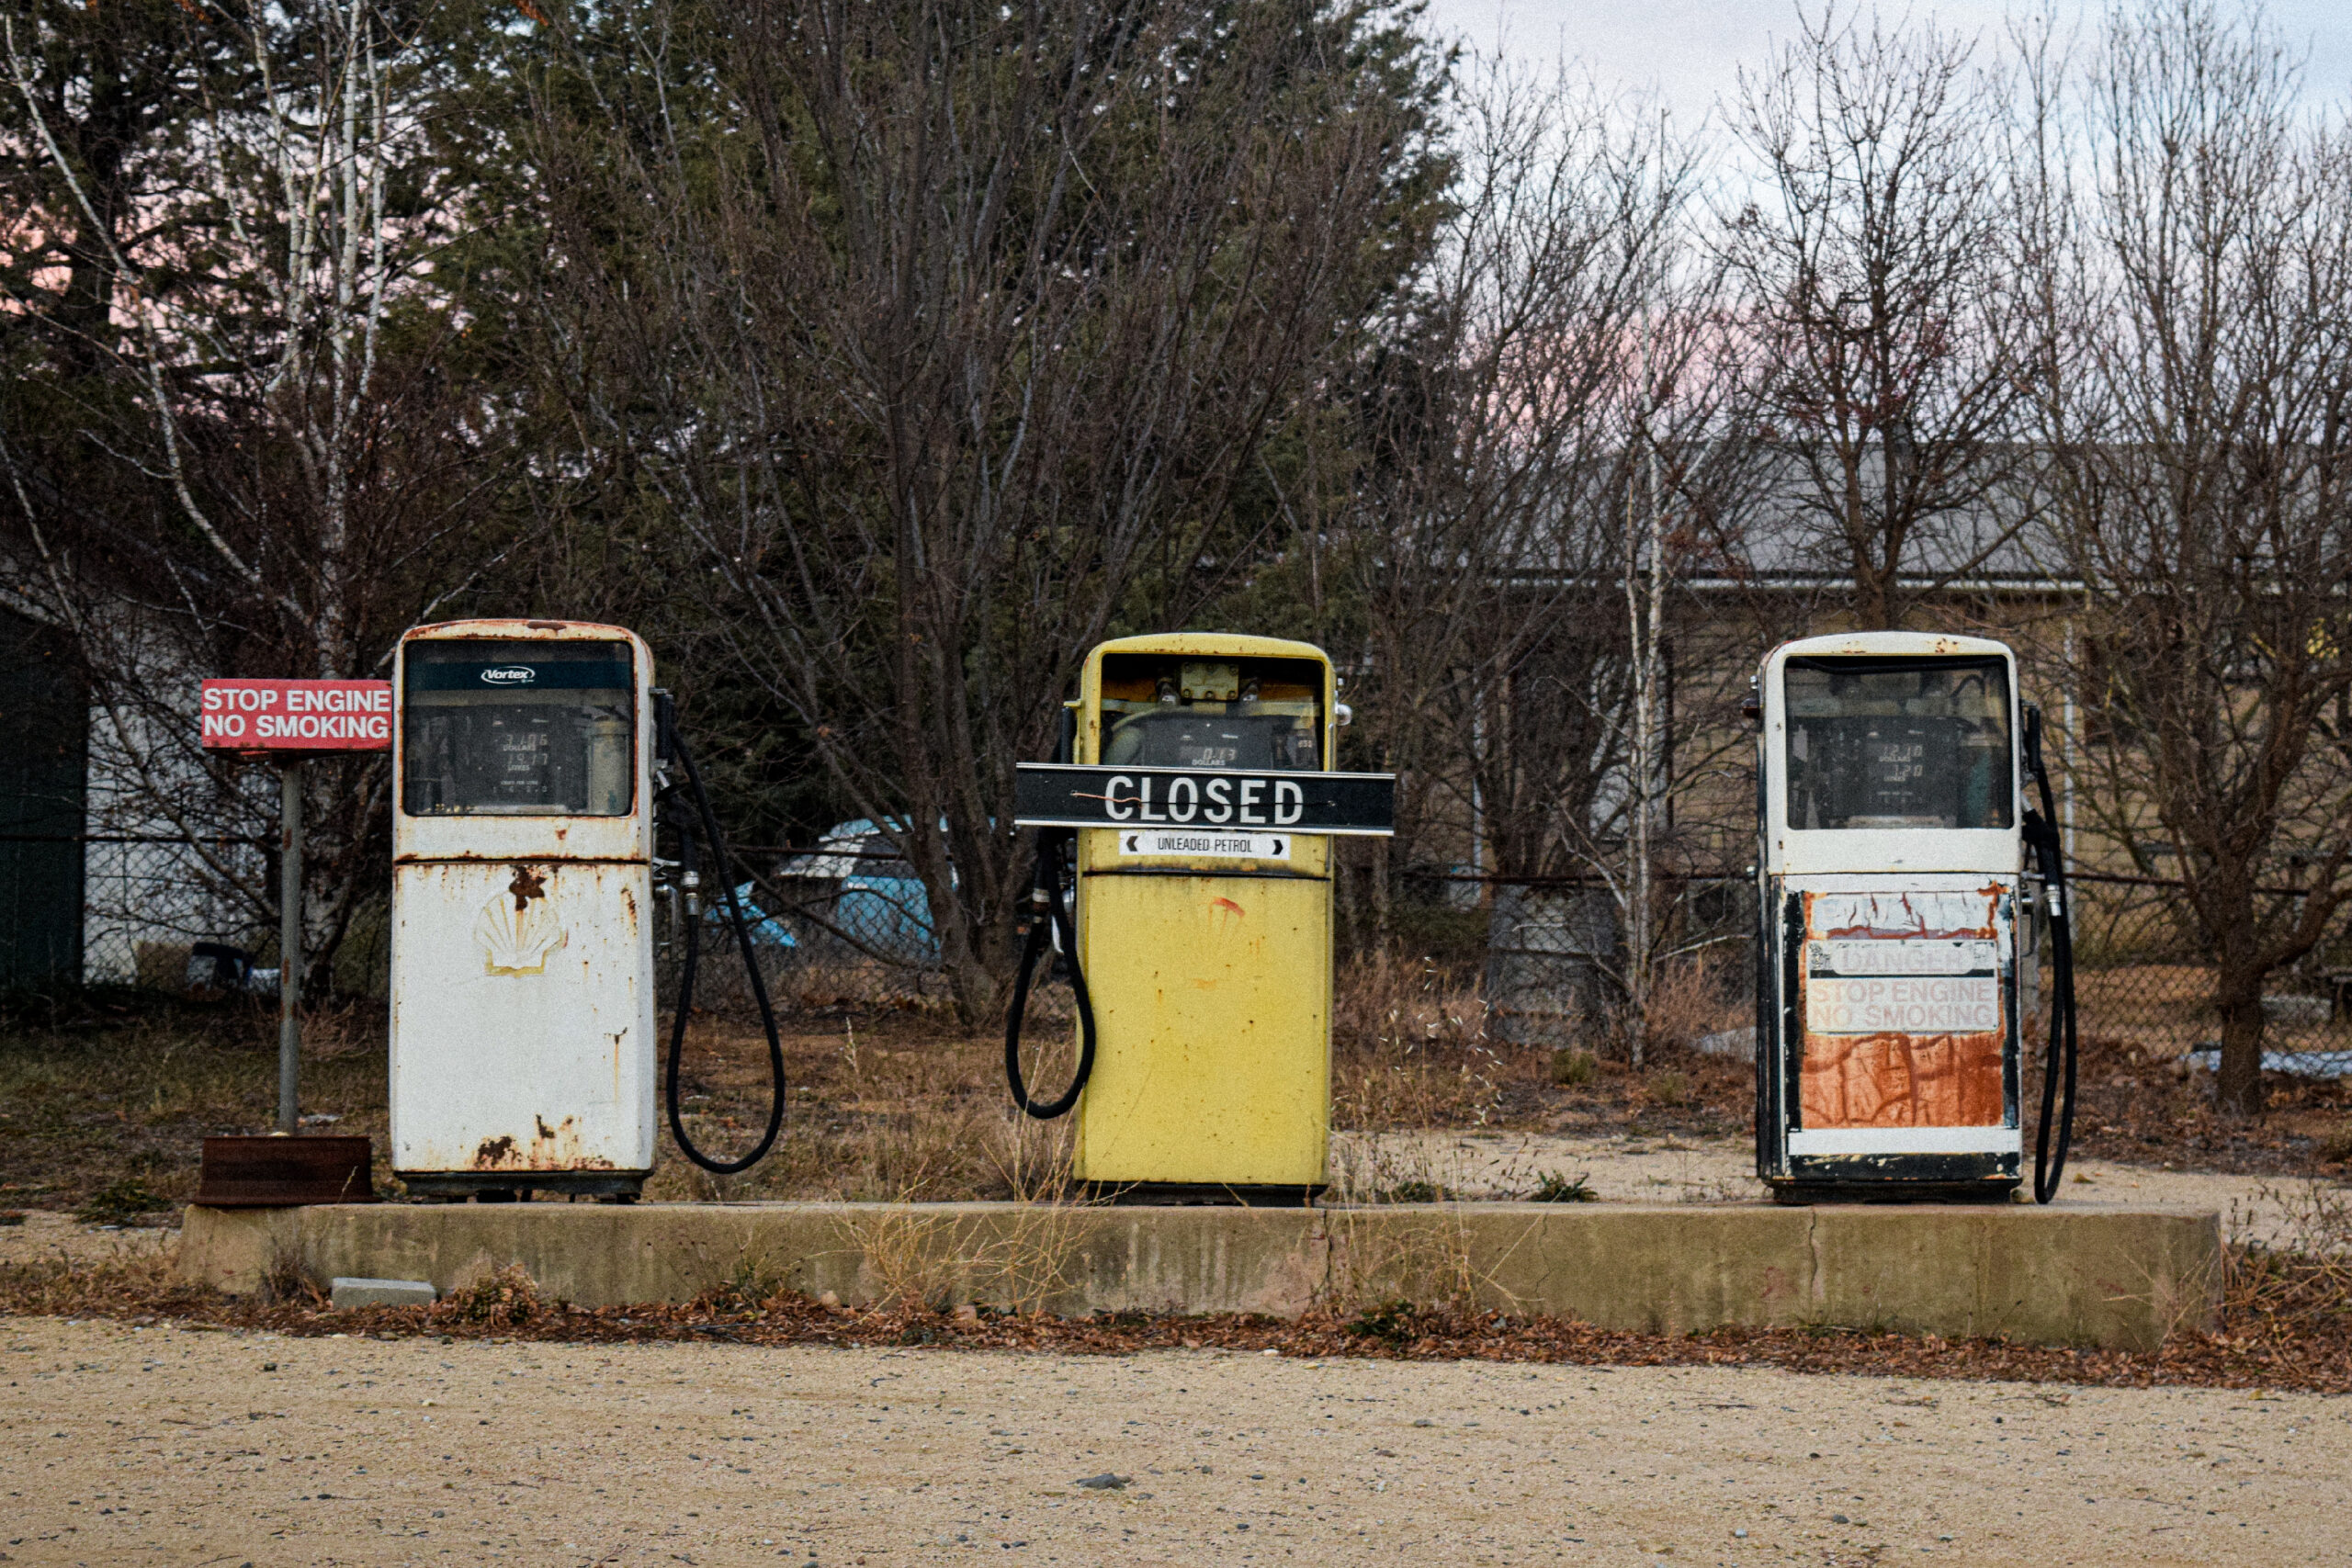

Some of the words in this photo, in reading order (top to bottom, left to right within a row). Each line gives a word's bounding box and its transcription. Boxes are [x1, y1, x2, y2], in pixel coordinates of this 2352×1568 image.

[484, 670, 529, 679] Vortex
[204, 688, 277, 712] STOP
[288, 689, 390, 713] ENGINE
[204, 715, 246, 738] NO
[256, 716, 389, 739] SMOKING
[1104, 775, 1304, 825] CLOSED
[1158, 838, 1210, 852] UNLEADED
[1215, 839, 1252, 853] PETROL
[1841, 949, 1963, 973] DANGER
[1811, 980, 1885, 1003] STOP
[1891, 980, 1993, 1003] ENGINE
[1812, 1005, 1853, 1027] NO
[1864, 1004, 1993, 1027] SMOKING
